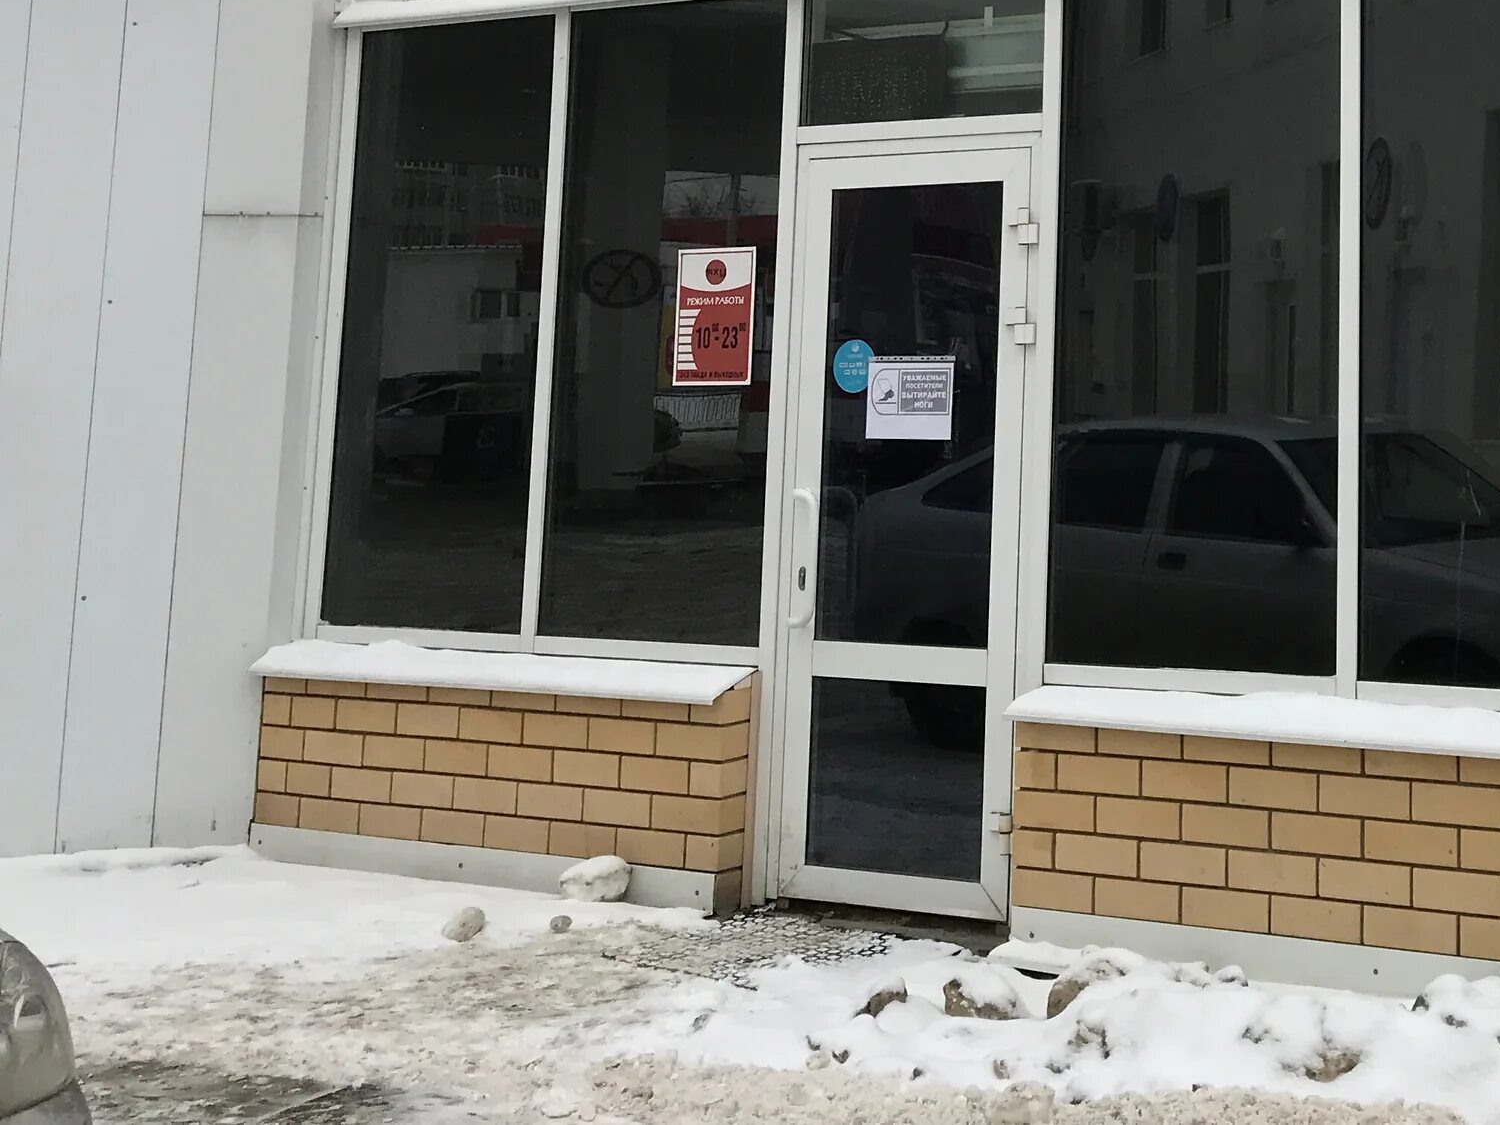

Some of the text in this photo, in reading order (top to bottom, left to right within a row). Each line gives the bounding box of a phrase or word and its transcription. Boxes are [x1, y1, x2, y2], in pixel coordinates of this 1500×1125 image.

[686, 296, 745, 306] РЕЖИМ РАБОТЫ
[902, 374, 947, 382] УВАЖАЕМЫЕ
[905, 382, 944, 390] ПОСЕТИТЕЛИ
[901, 391, 947, 400] ВЫТИРАЙТЕ
[914, 401, 934, 409] НОГИ
